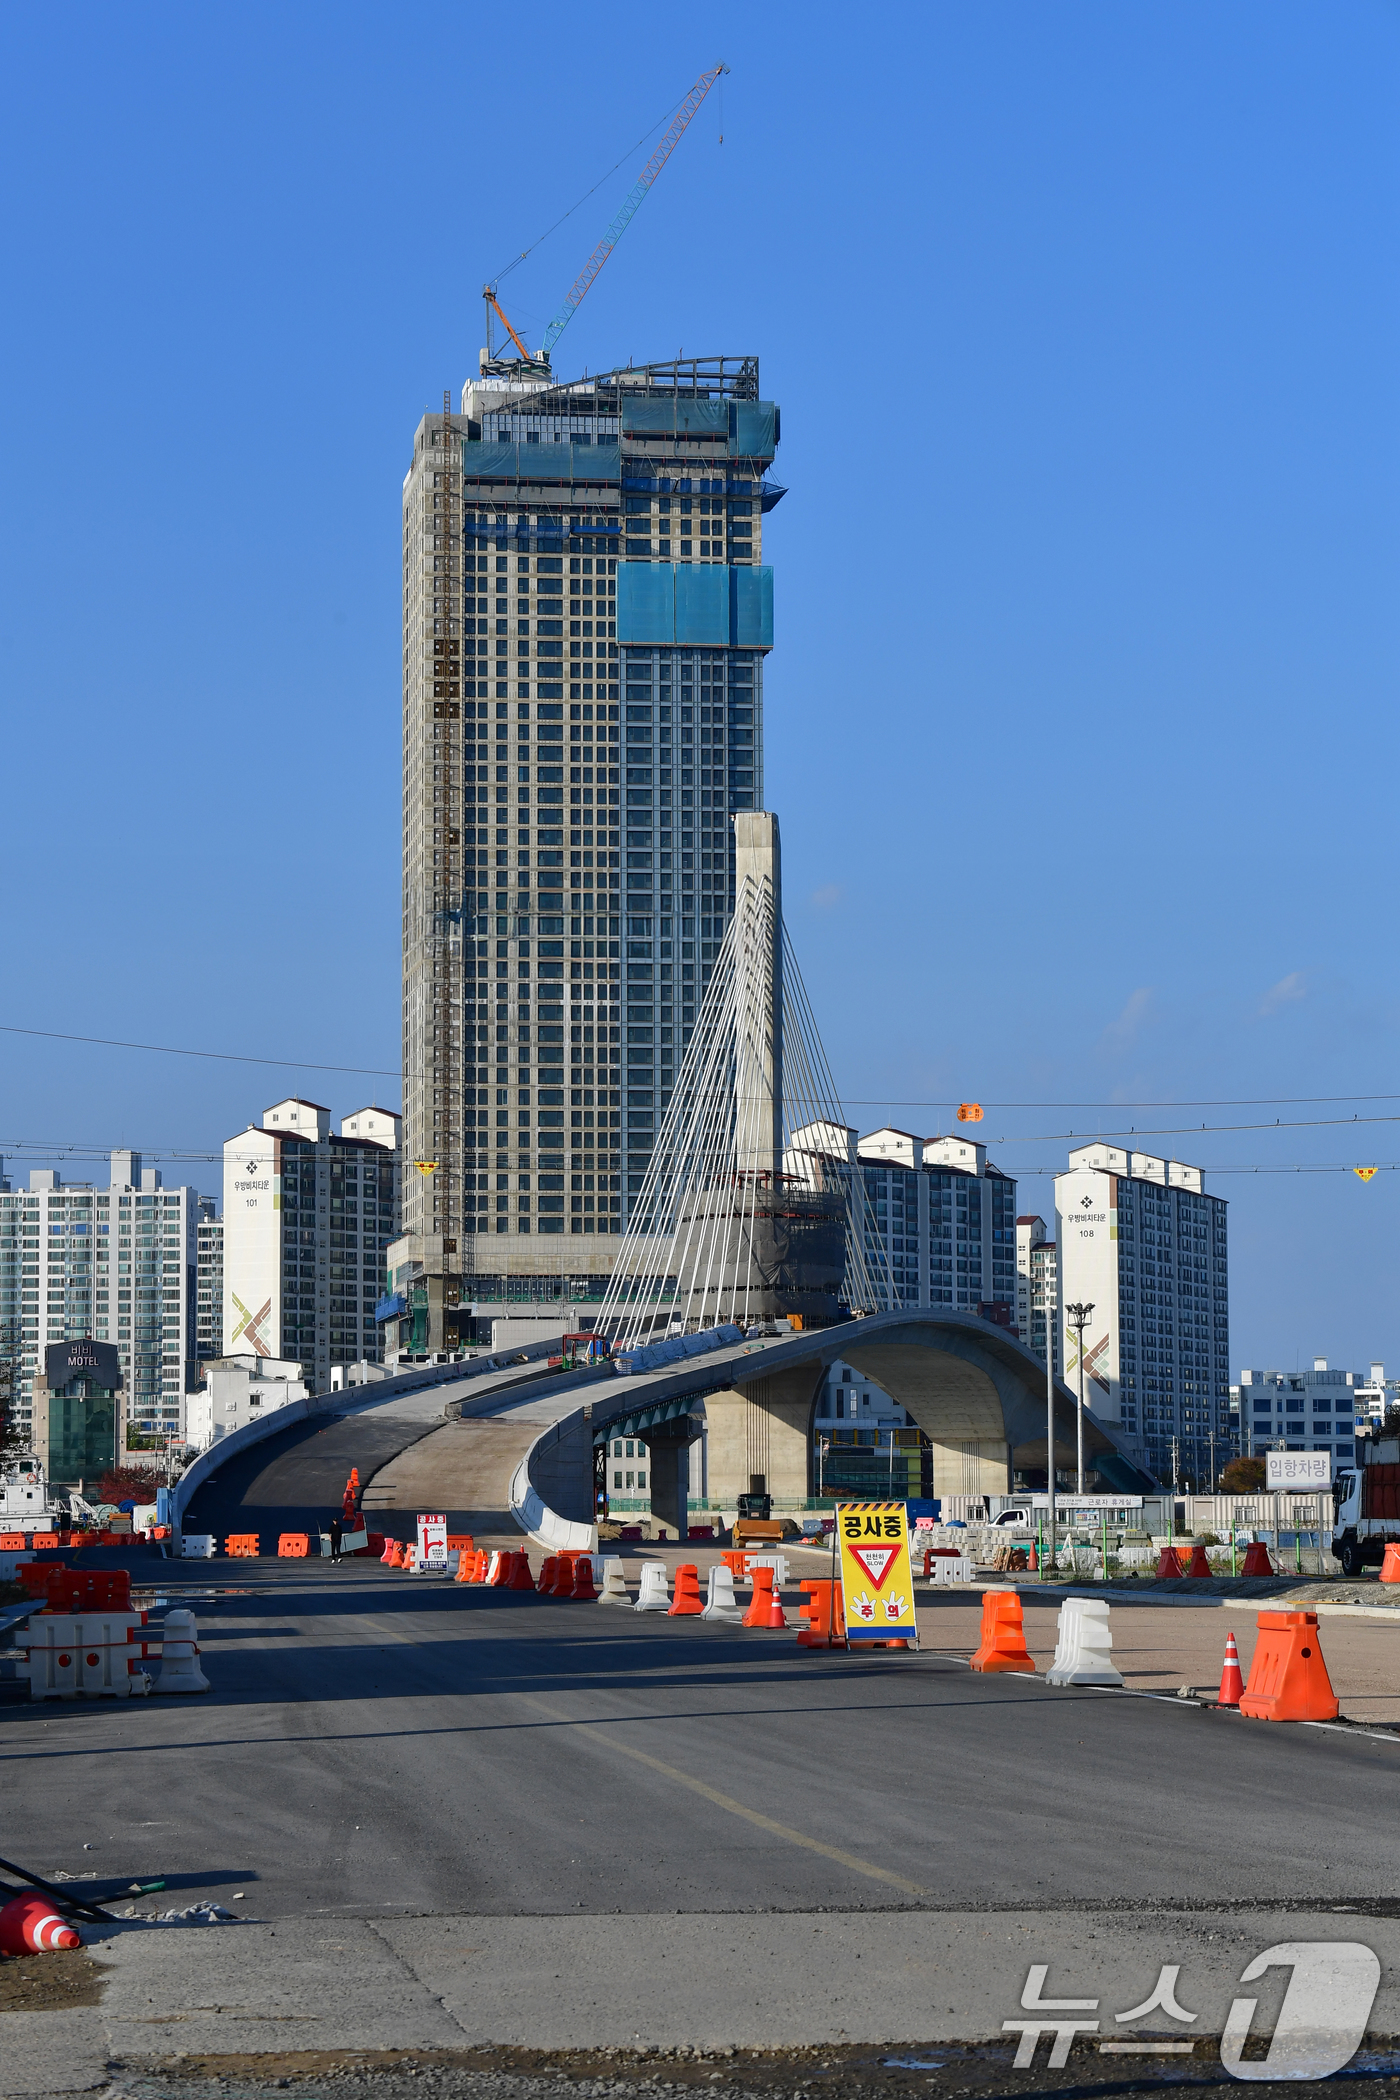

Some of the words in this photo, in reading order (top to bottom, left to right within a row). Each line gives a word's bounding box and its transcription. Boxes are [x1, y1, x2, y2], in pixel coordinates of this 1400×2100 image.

[246, 1199, 258, 1207] 101
[1080, 1230, 1094, 1238] 108
[71, 1345, 92, 1356] 비비
[67, 1356, 99, 1366] MOTEL
[1269, 1459, 1327, 1478] 입항차량
[1088, 1498, 1108, 1506] 근로자
[1111, 1498, 1132, 1506] 휴게실
[844, 1516, 902, 1538] 공사중
[865, 1553, 885, 1561] 천천히
